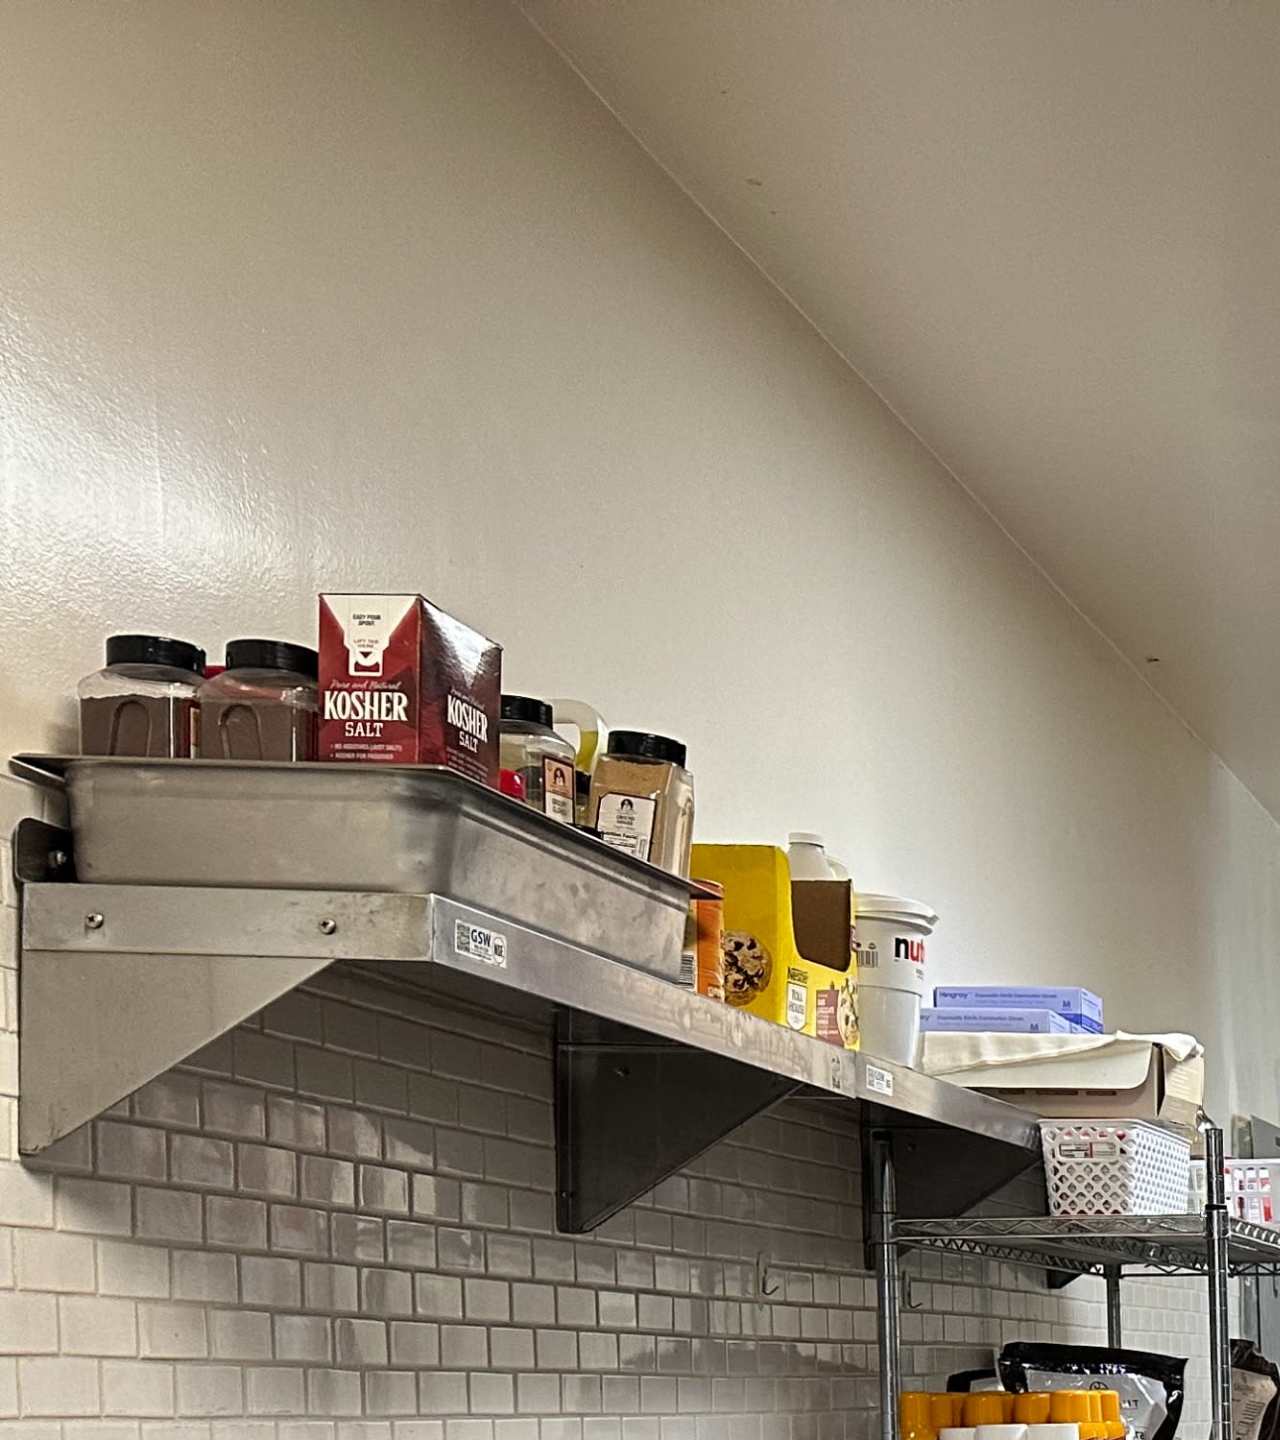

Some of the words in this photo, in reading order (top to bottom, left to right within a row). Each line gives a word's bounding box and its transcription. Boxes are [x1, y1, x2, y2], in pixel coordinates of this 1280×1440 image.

[323, 690, 409, 722] KOSHER
[447, 694, 488, 743] KOSHER
[344, 721, 384, 738] SALT
[458, 730, 479, 754] SALT
[470, 929, 492, 947] GSW
[1062, 1000, 1071, 1009] M
[1030, 1023, 1039, 1031] M
